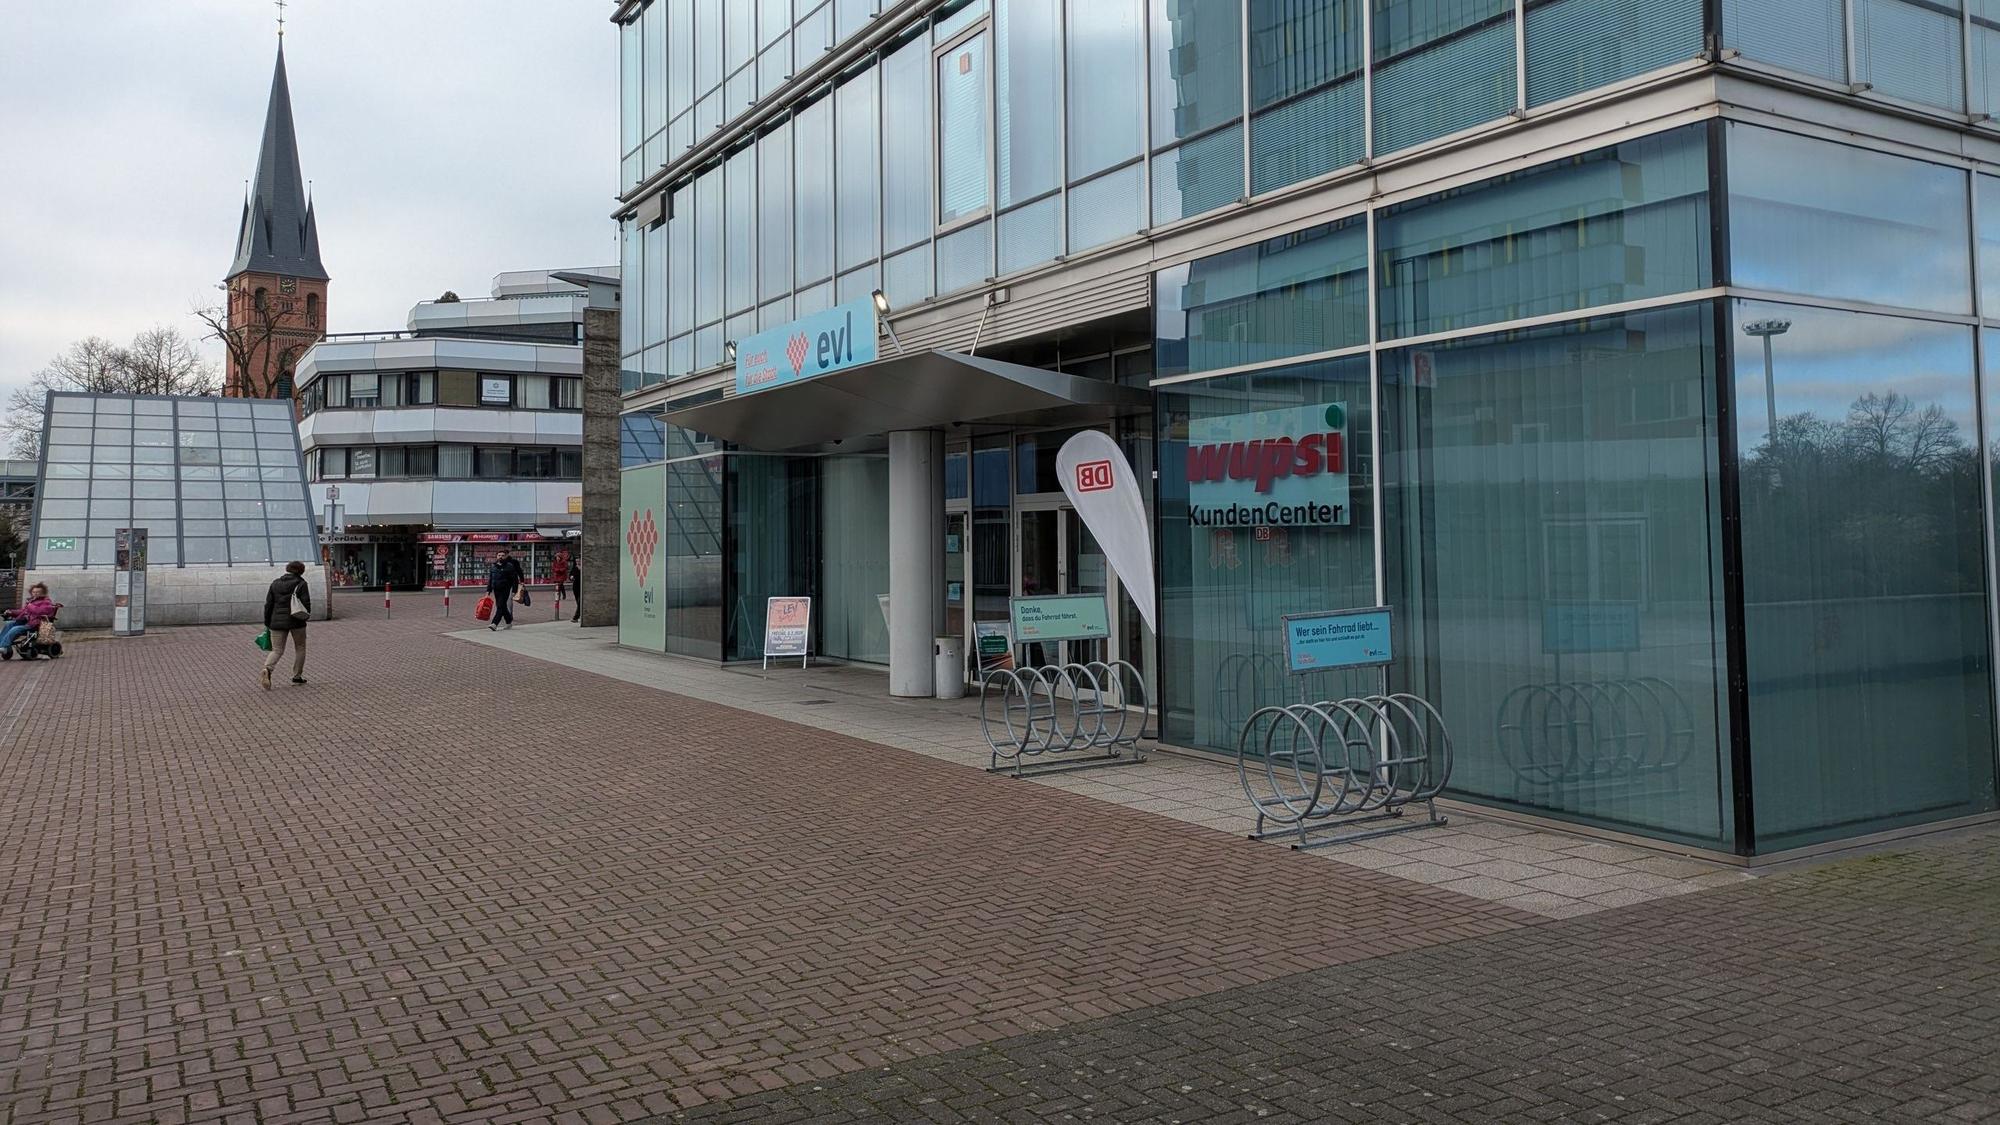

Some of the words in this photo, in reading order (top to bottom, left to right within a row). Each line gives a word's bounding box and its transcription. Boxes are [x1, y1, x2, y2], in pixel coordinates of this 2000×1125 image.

[817, 311, 852, 369] evl
[1186, 405, 1343, 493] wupsi
[1187, 500, 1343, 526] KundenCenter
[1256, 527, 1270, 539] DB
[1296, 626, 1309, 637] Wer
[1311, 625, 1327, 636] sein
[1328, 622, 1356, 634] Fahrrad
